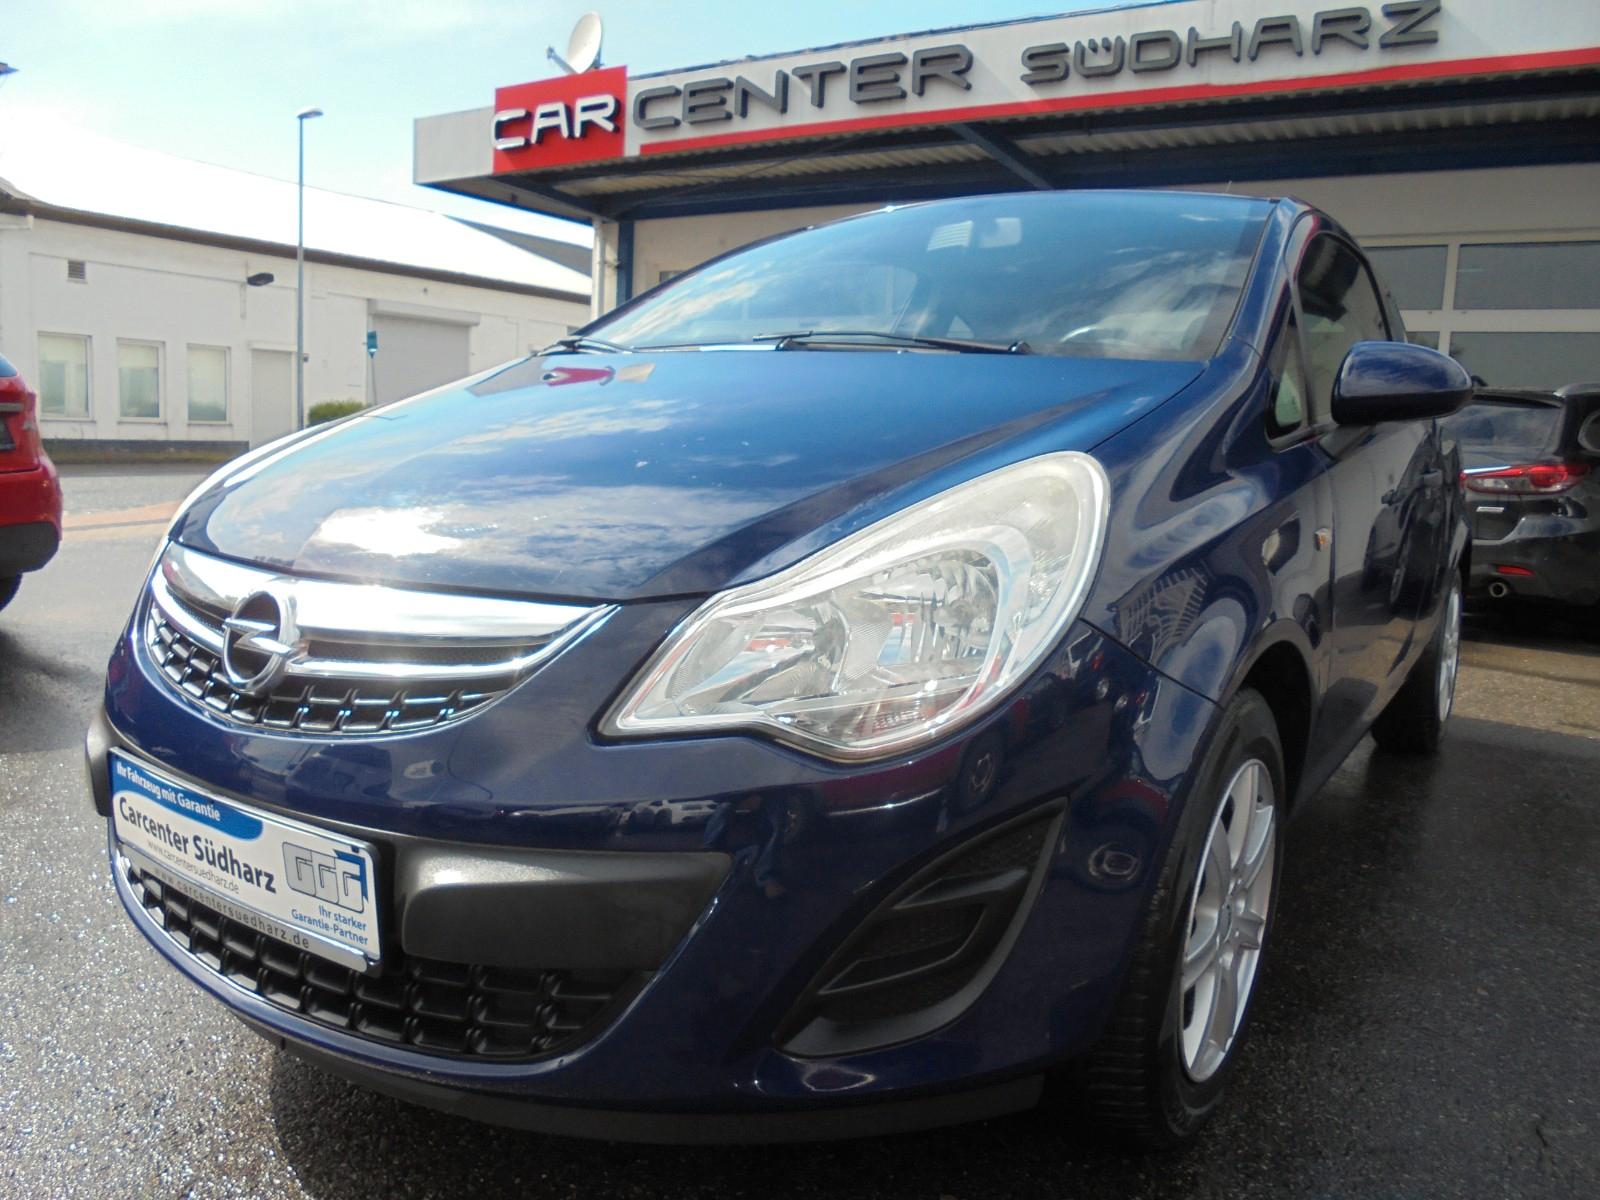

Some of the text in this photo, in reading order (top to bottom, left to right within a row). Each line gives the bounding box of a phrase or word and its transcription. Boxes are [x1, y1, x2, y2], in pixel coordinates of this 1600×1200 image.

[491, 0, 1441, 150] CAR CENTER SÜDHARZ
[117, 762, 221, 822] Ihr Fahrzeug mit Garantie
[120, 797, 277, 894] Carcenter Südharz
[291, 909, 368, 945] Garantie-Partner
[318, 905, 367, 931] Ihr starker
